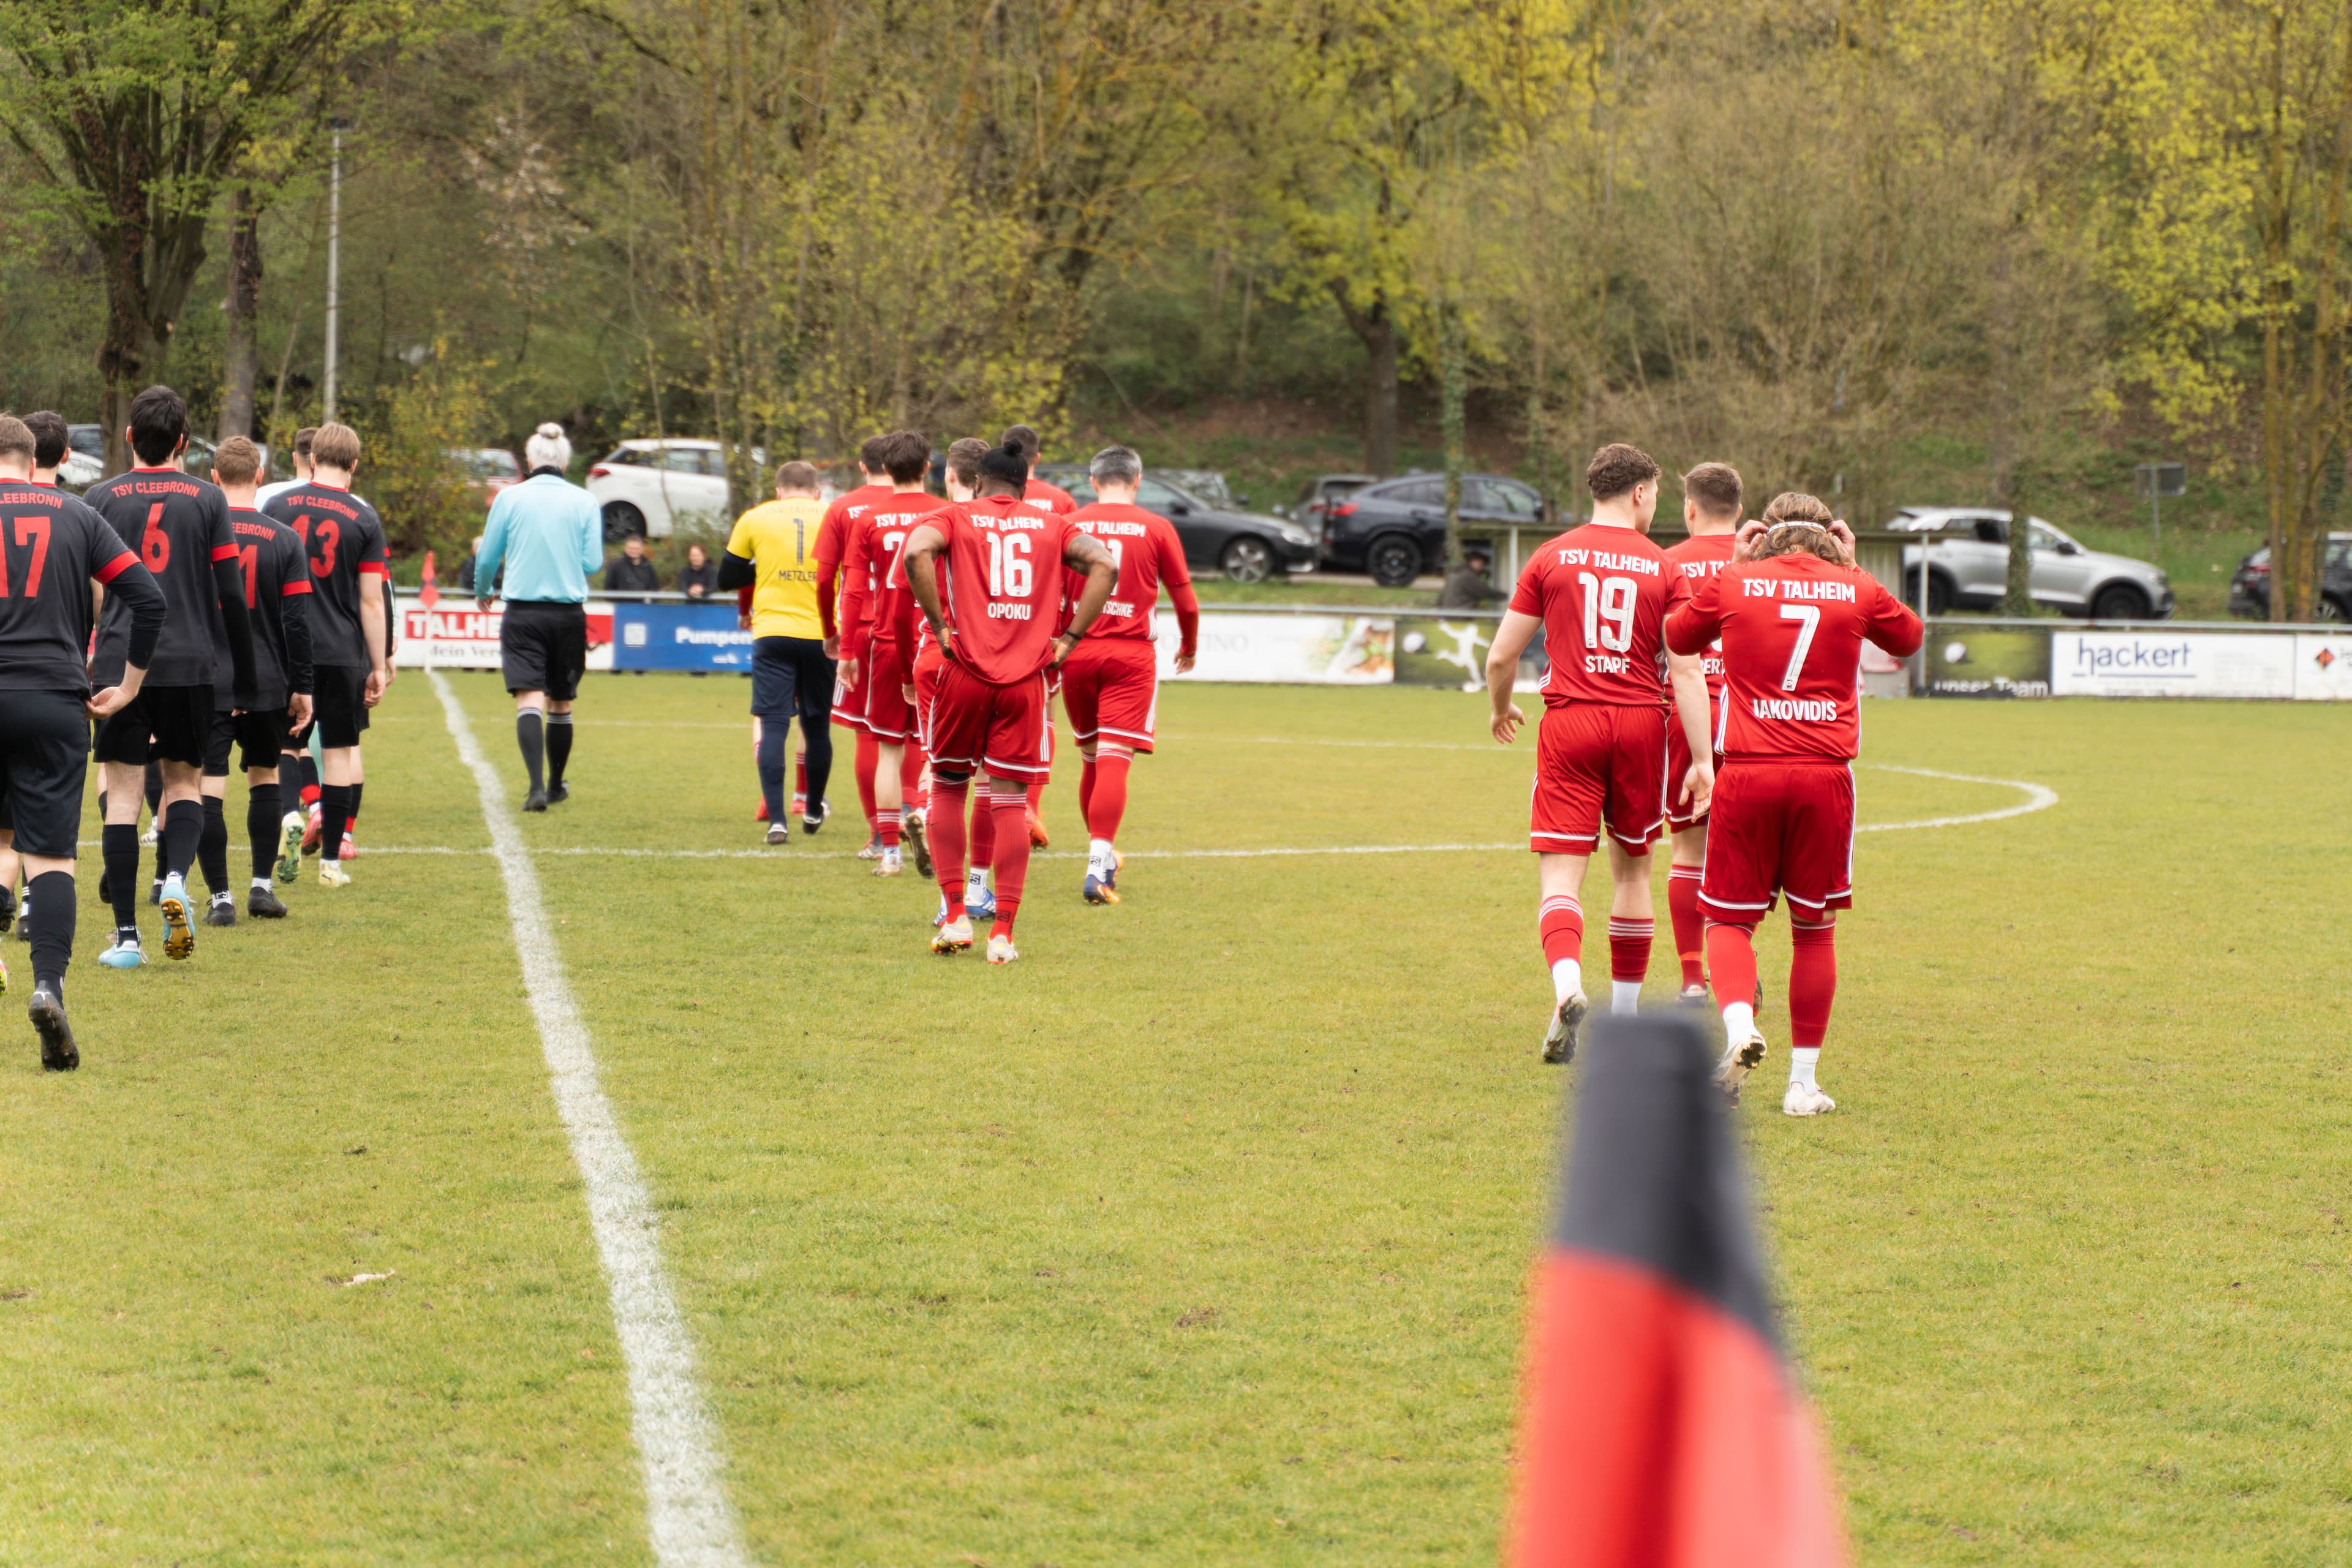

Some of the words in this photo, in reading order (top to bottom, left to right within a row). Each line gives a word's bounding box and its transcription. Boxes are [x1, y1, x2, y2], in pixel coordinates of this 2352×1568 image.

[111, 484, 132, 498] TSV
[135, 481, 200, 497] CLEEBRONN
[287, 495, 304, 507] TSV
[306, 496, 358, 521] CLEEBRONN
[874, 513, 896, 527] TSV
[970, 514, 995, 528] TSV
[1096, 521, 1145, 537] TALHEIM
[141, 502, 170, 573] 6
[793, 518, 804, 565] 1
[986, 532, 1031, 597] 16
[1559, 549, 1589, 565] TSV
[1593, 551, 1659, 576] TALHEIM
[1743, 579, 1777, 597] TSV
[1782, 581, 1856, 603] TALHEIM
[987, 602, 1031, 620] OPOKU
[1578, 571, 1637, 653] 19
[408, 614, 503, 638] TALHE
[1780, 604, 1821, 692] 7
[2079, 638, 2191, 676] hackert
[1585, 655, 1631, 674] STAPF
[1753, 699, 1838, 722] IAKOVIDIS
